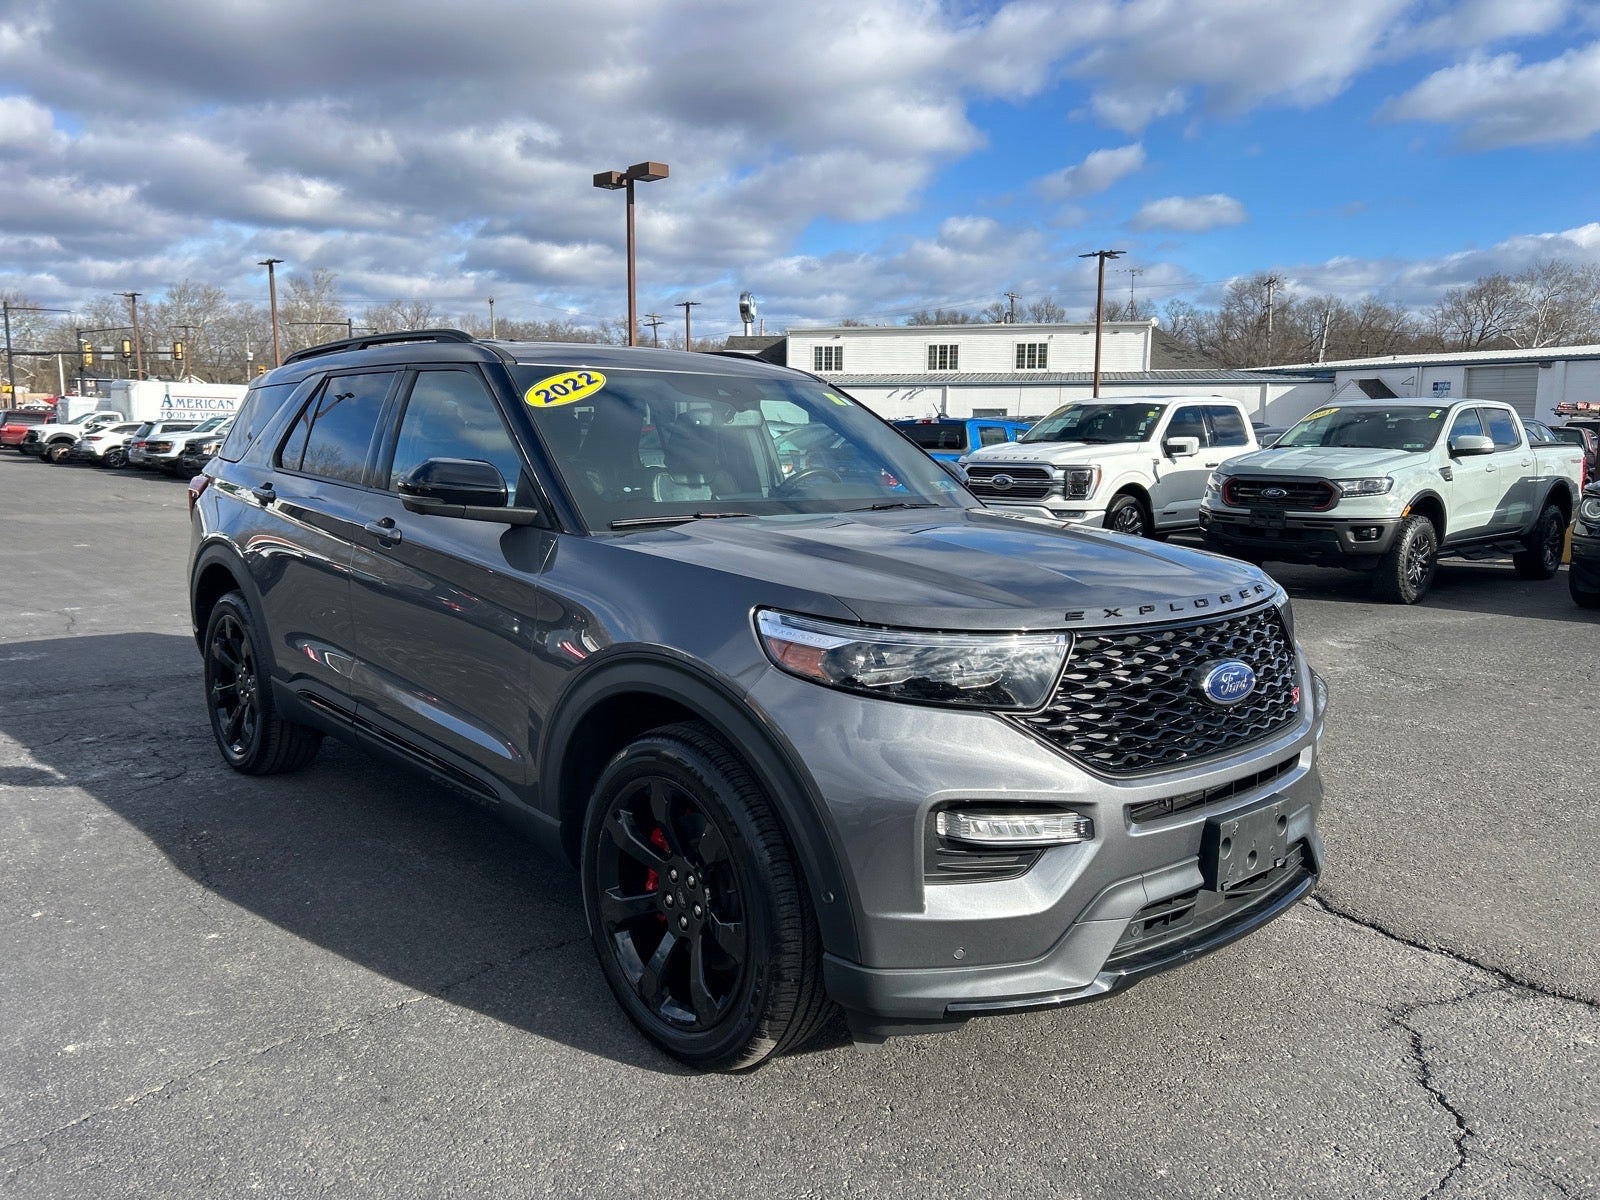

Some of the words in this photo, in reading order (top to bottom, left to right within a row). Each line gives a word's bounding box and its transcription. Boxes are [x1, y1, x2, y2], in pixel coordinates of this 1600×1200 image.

[535, 372, 600, 404] 2022
[161, 393, 235, 410] AMERICAN
[161, 411, 186, 419] FOOD
[1064, 584, 1266, 622] EXPLORER
[1220, 671, 1249, 696] Ford
